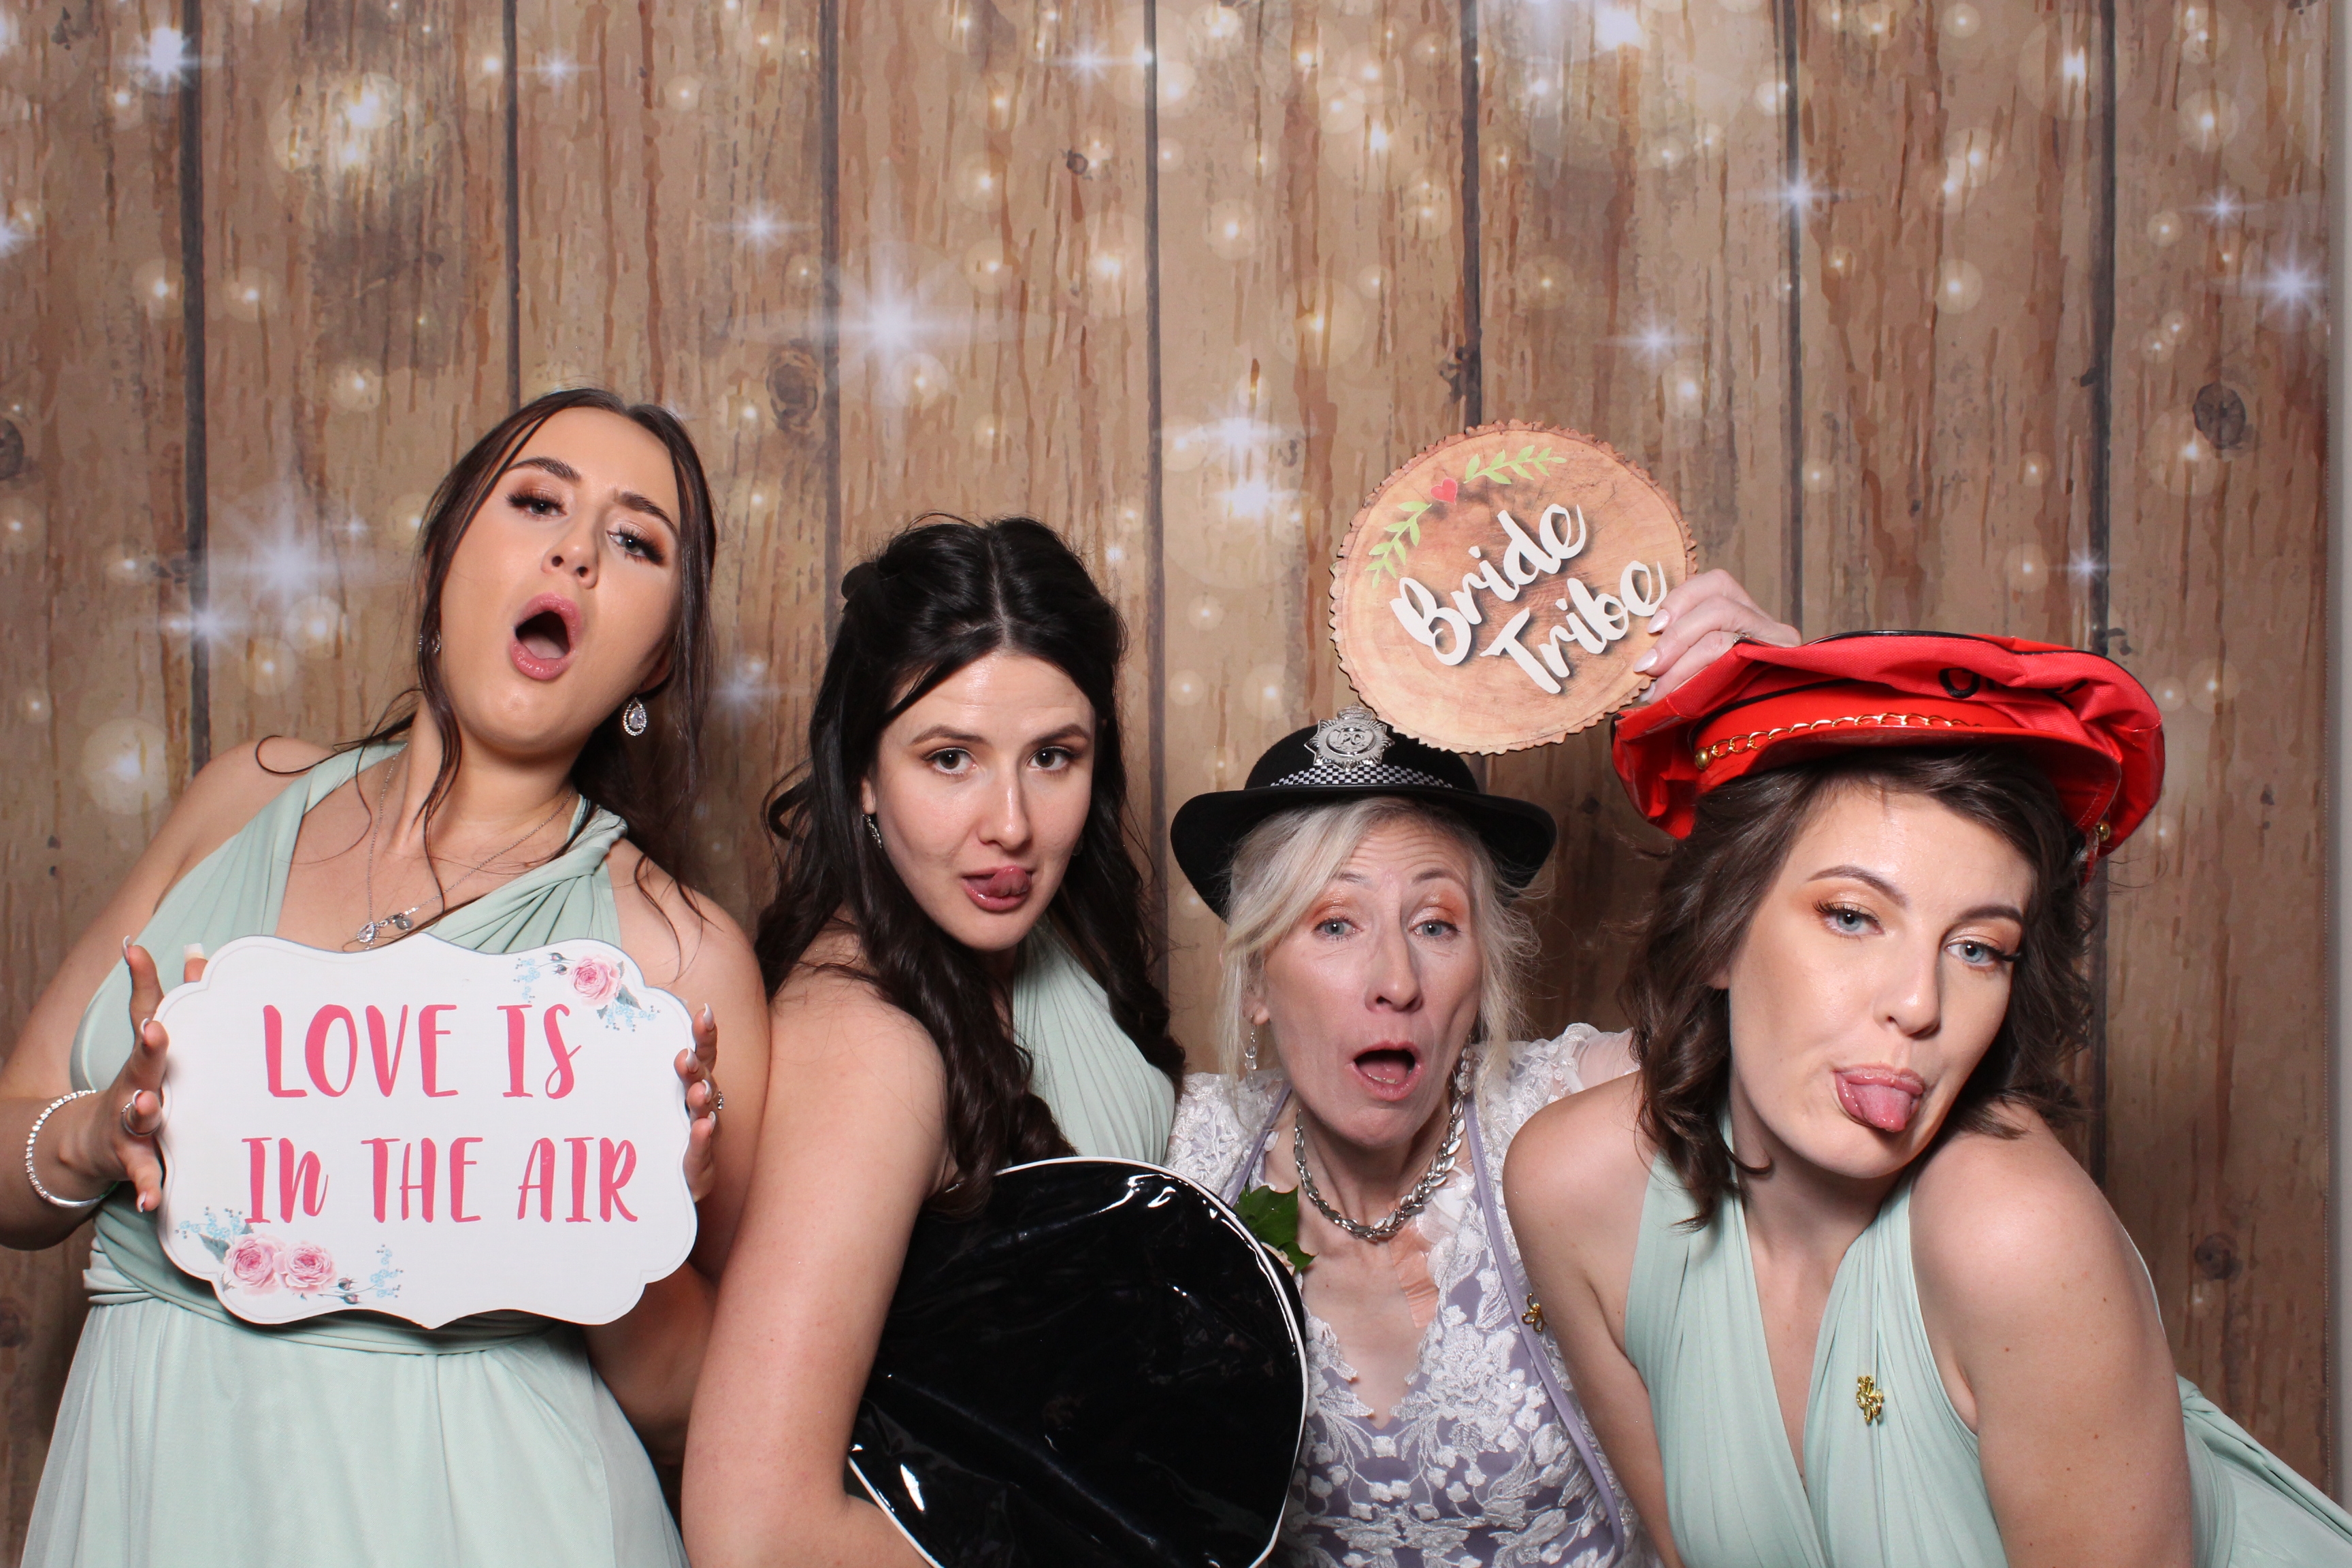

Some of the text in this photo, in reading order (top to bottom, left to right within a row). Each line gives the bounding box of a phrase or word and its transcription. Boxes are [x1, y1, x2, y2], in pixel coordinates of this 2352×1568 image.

[1389, 504, 1586, 666] Bride
[1480, 560, 1668, 694] Tribe
[263, 1004, 582, 1099] LOVE IS
[361, 1137, 484, 1223] THE
[518, 1137, 638, 1223] AIR
